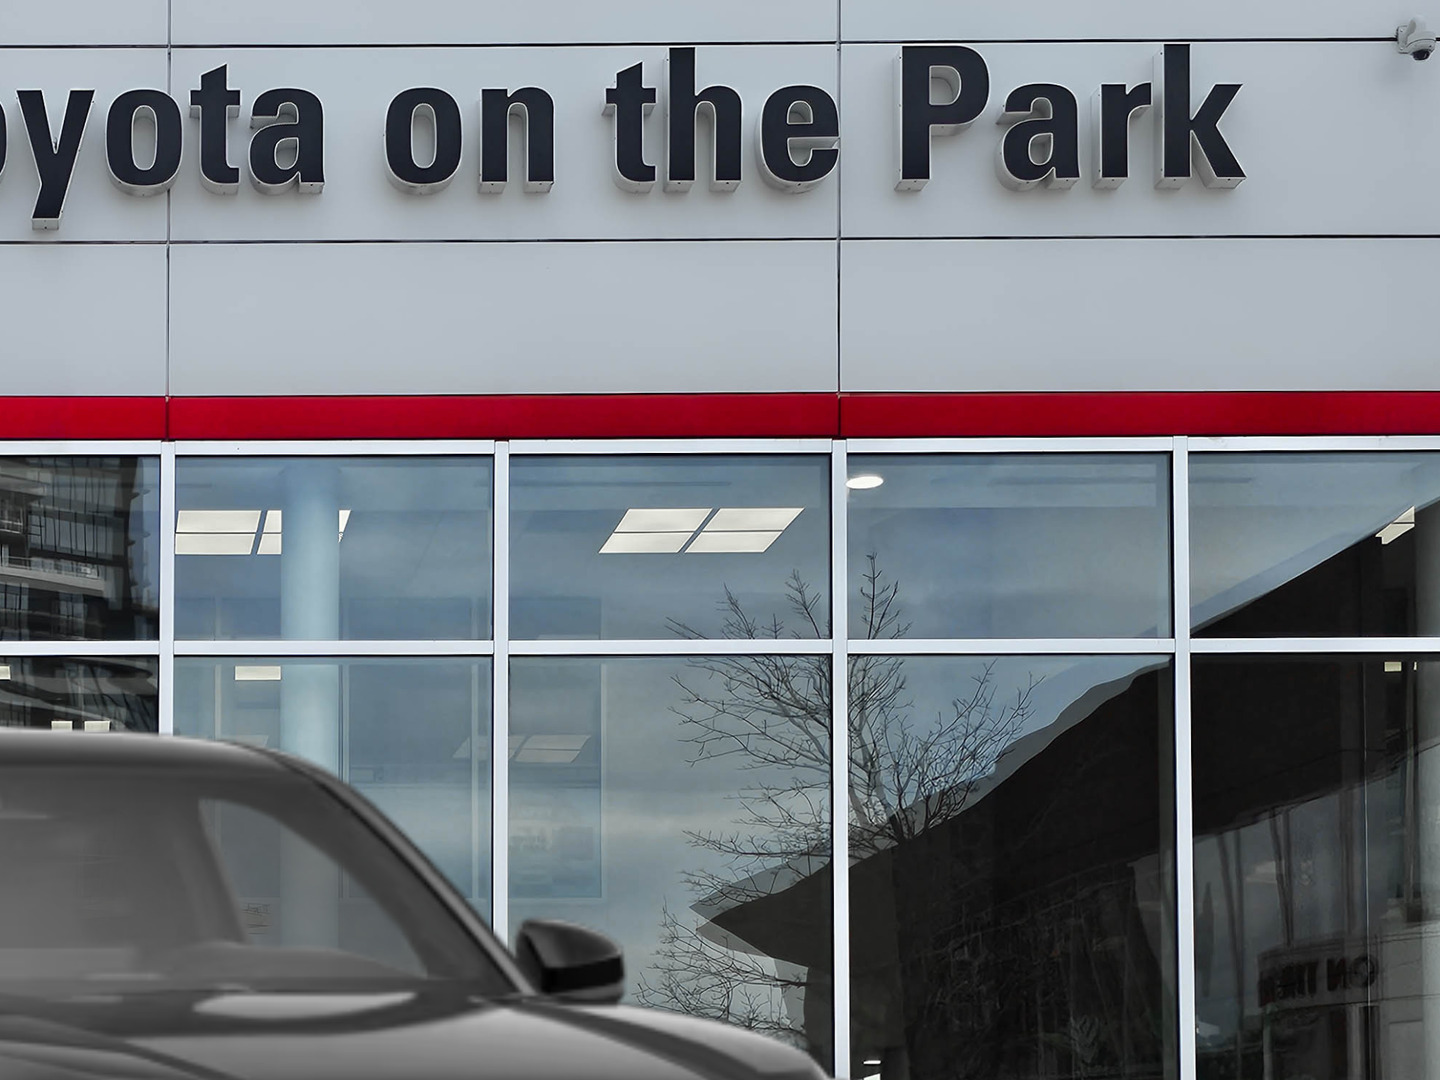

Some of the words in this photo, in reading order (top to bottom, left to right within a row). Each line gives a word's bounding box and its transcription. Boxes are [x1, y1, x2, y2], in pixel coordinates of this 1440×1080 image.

[385, 86, 554, 194] on
[602, 47, 841, 194] the
[894, 44, 1247, 192] Park
